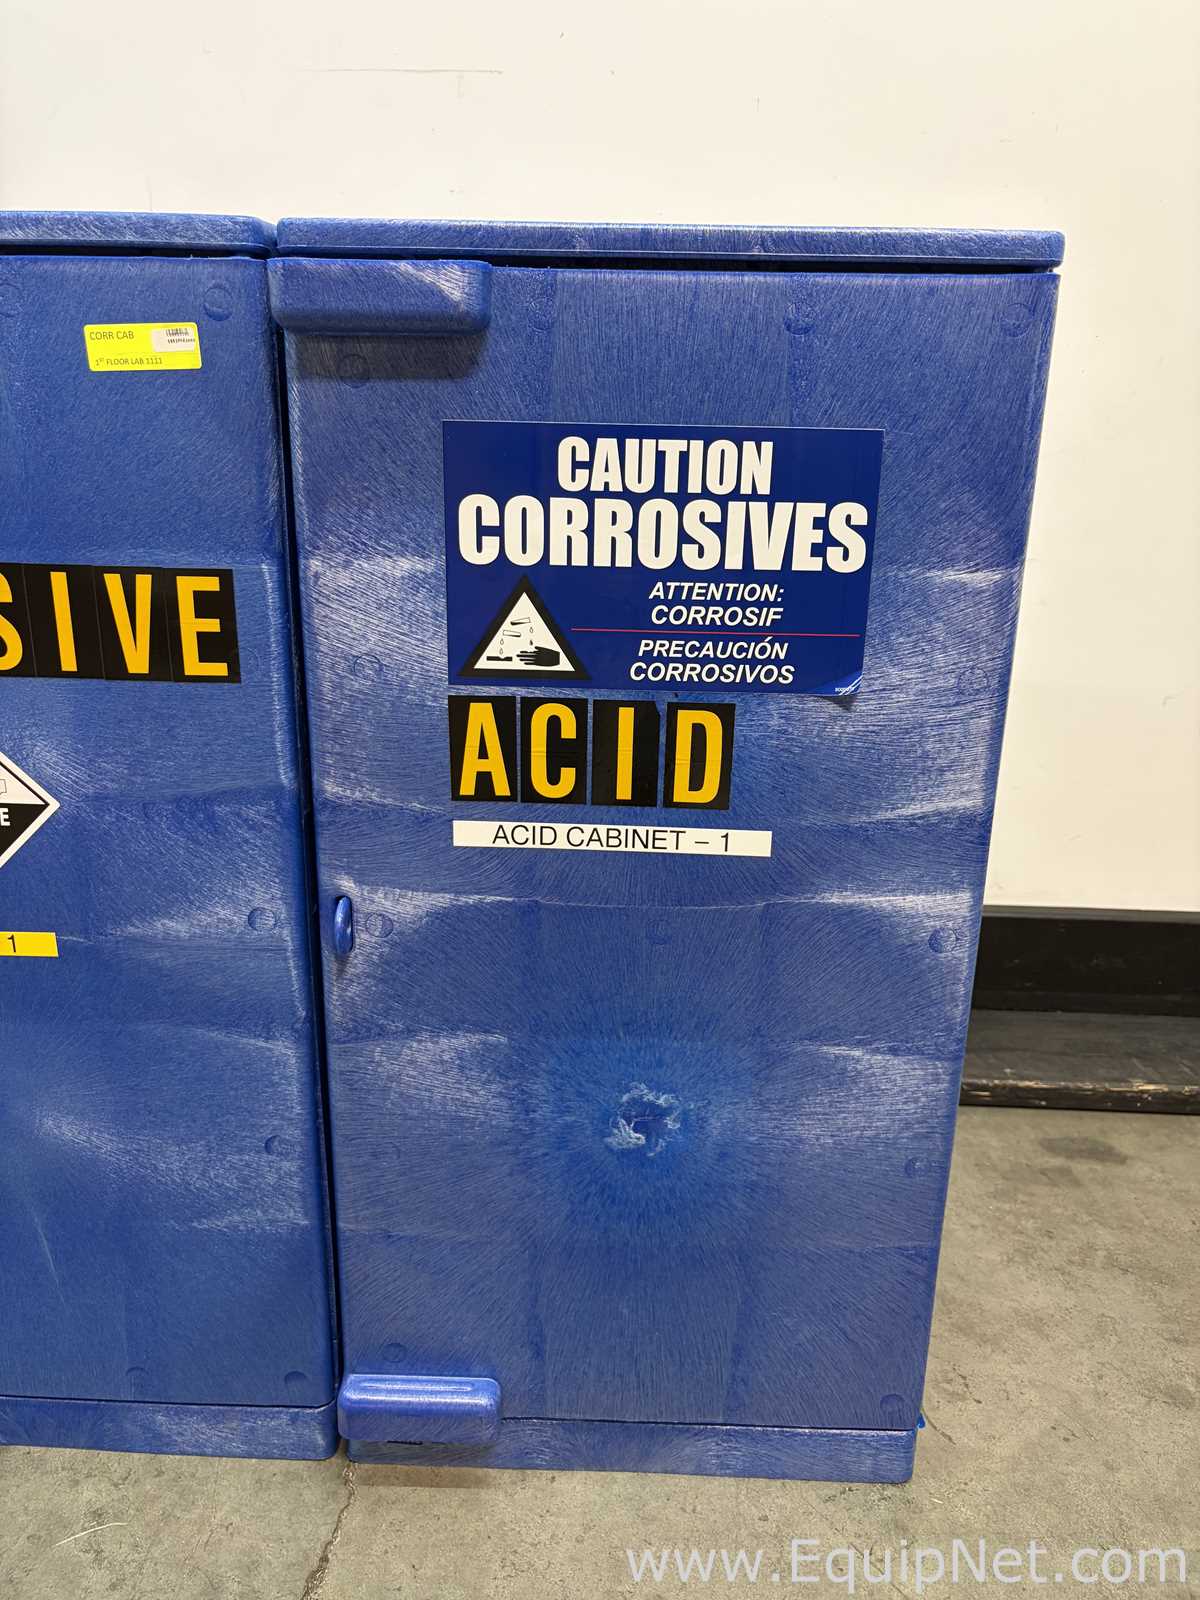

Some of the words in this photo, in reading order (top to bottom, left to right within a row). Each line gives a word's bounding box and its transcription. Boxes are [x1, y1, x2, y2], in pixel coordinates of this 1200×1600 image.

[89, 331, 114, 340] CORR
[116, 330, 135, 340] CAB
[106, 357, 129, 366] FLOOR
[130, 357, 144, 366] LAB
[557, 436, 774, 495] CAUTION
[458, 493, 869, 573] CORROSIVES
[648, 581, 785, 603] ATTENTION:
[650, 604, 784, 626] CORROSIF
[637, 635, 789, 661] PRECAUCIÓN
[629, 661, 795, 685] CORROSIVOS
[459, 702, 723, 804] ACID
[492, 824, 558, 847] ACID
[566, 826, 686, 851] CABINET
[720, 832, 730, 852] 1
[8, 934, 17, 953] 1
